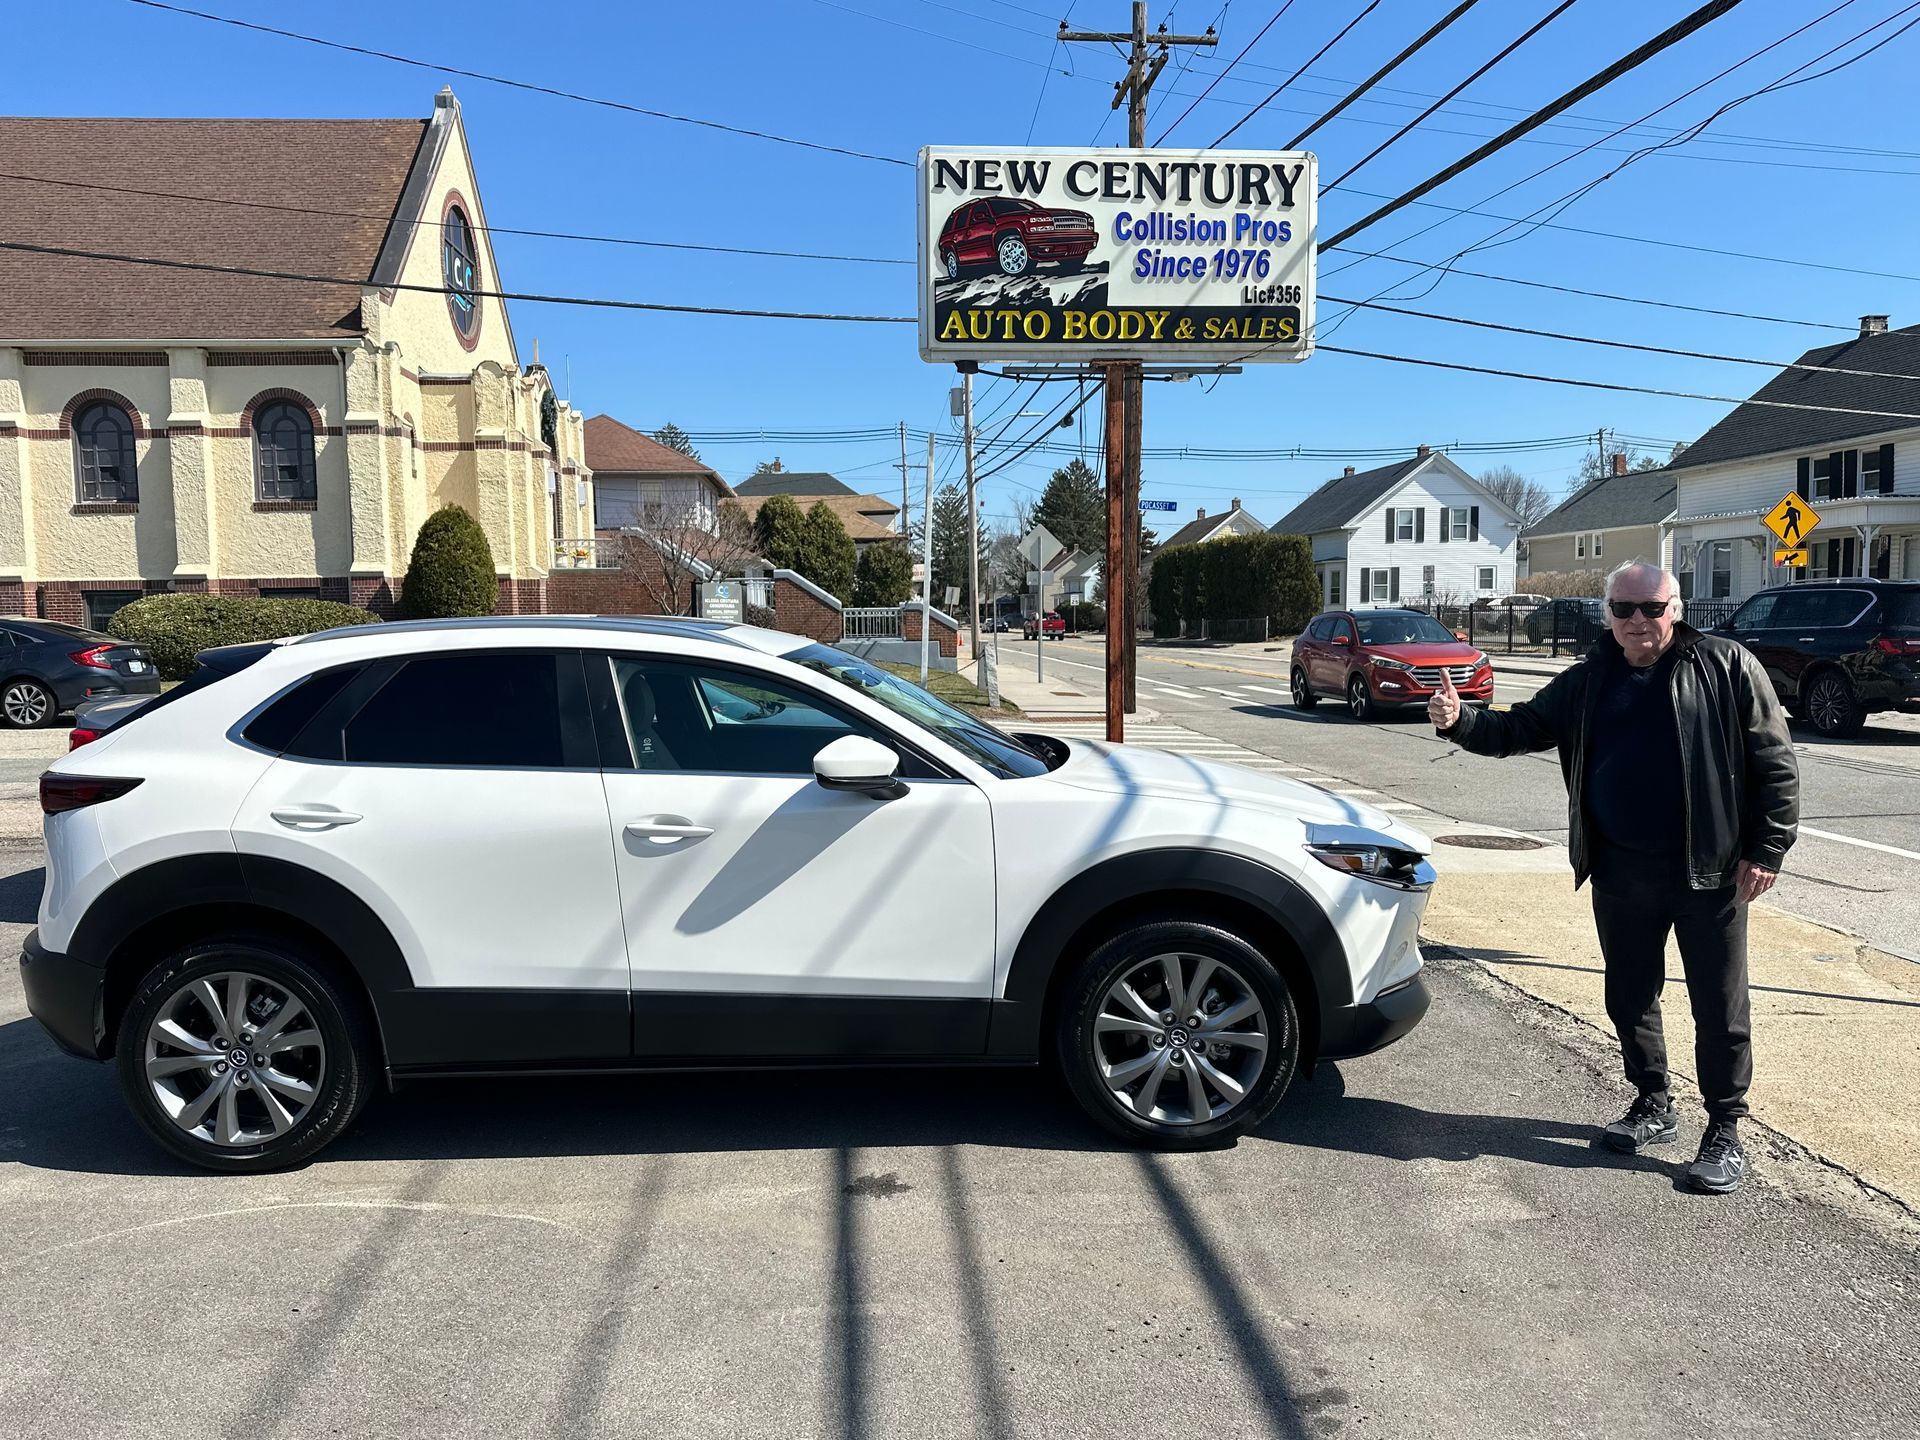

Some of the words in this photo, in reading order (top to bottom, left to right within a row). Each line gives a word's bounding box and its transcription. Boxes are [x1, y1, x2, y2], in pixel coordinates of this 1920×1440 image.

[932, 159, 1052, 195] NEW
[1064, 160, 1304, 207] CENTURY
[1115, 211, 1227, 241] Collision
[1235, 213, 1292, 242] Pros
[1135, 248, 1207, 278] Since
[1213, 249, 1271, 278] 1976
[1244, 285, 1301, 304] Lic#356
[940, 310, 1050, 340] AUTO
[1062, 310, 1170, 340] BODY
[1174, 318, 1196, 340] &
[1203, 317, 1295, 339] SALES
[1141, 501, 1170, 510] POCASSET
